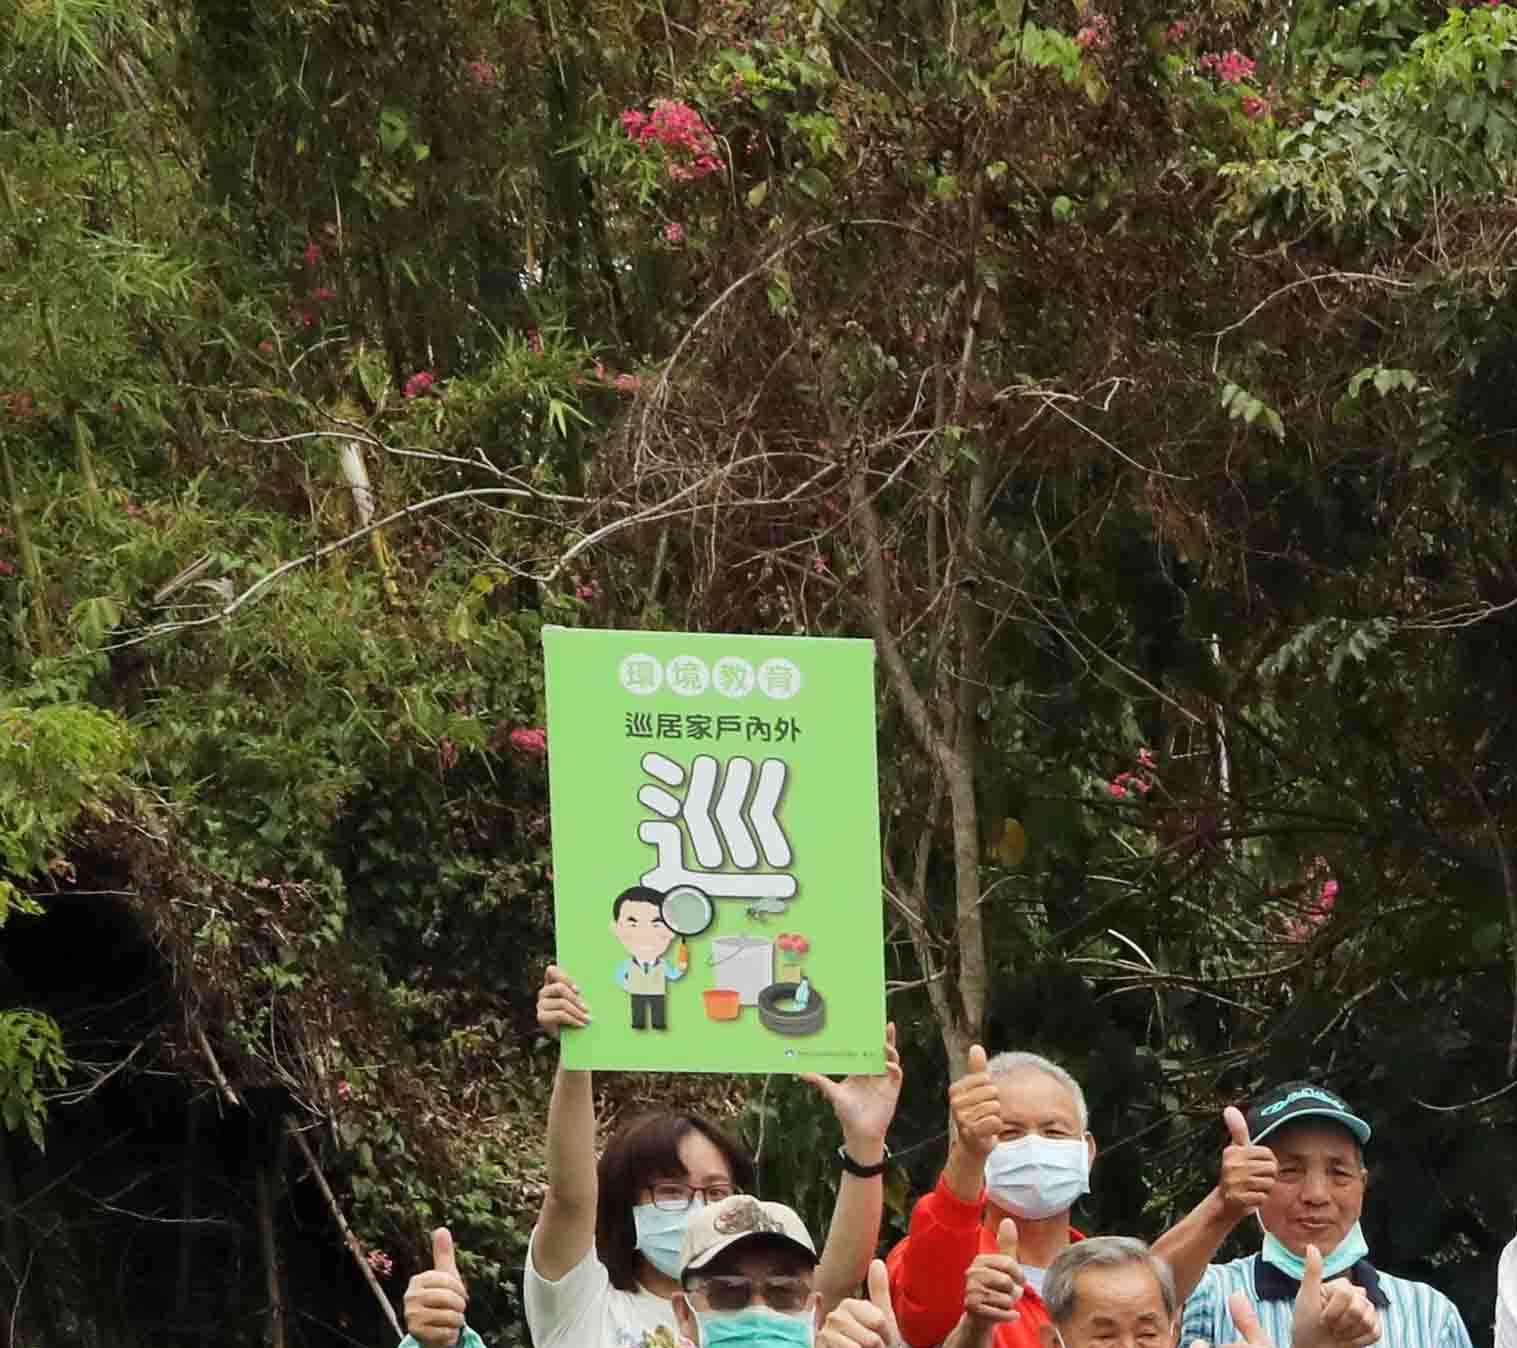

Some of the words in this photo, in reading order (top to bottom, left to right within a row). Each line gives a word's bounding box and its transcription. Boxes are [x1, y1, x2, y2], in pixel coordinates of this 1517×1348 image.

[620, 655, 799, 697] 環境教育
[625, 711, 801, 744] 巡居家戶內外
[637, 751, 799, 899] 巡
